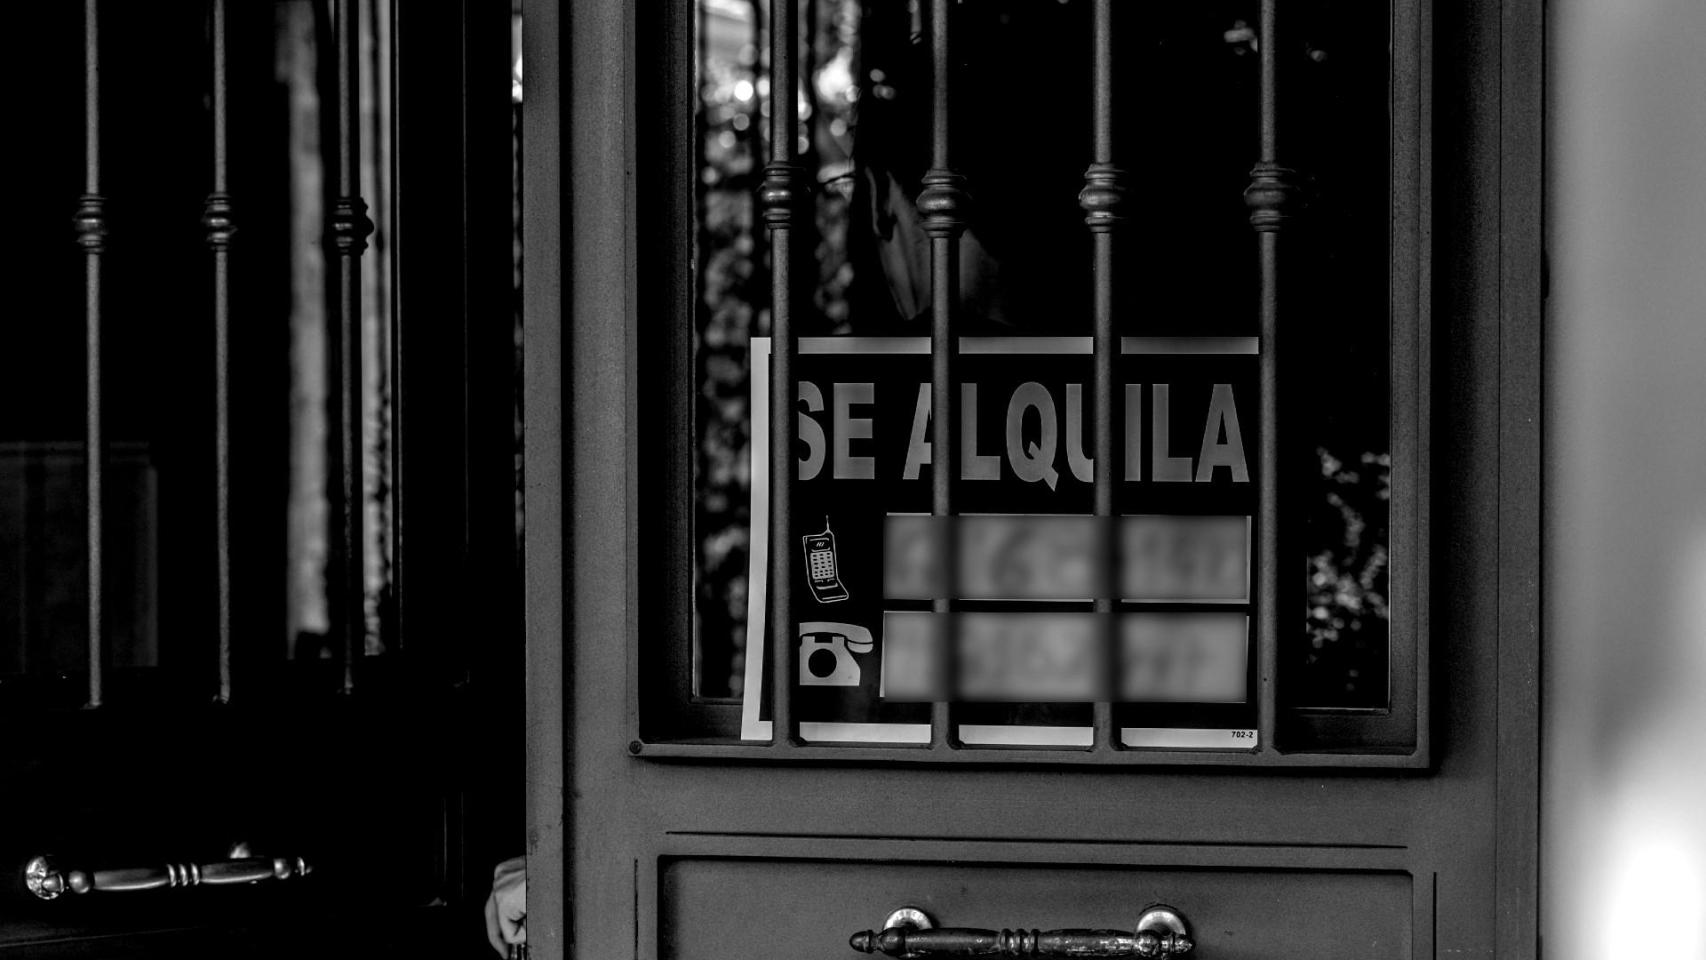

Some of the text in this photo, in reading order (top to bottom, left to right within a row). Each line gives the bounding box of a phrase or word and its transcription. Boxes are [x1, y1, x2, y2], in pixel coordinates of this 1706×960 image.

[798, 380, 1250, 491] SE ALQUILA
[1231, 730, 1254, 739] 702-2
